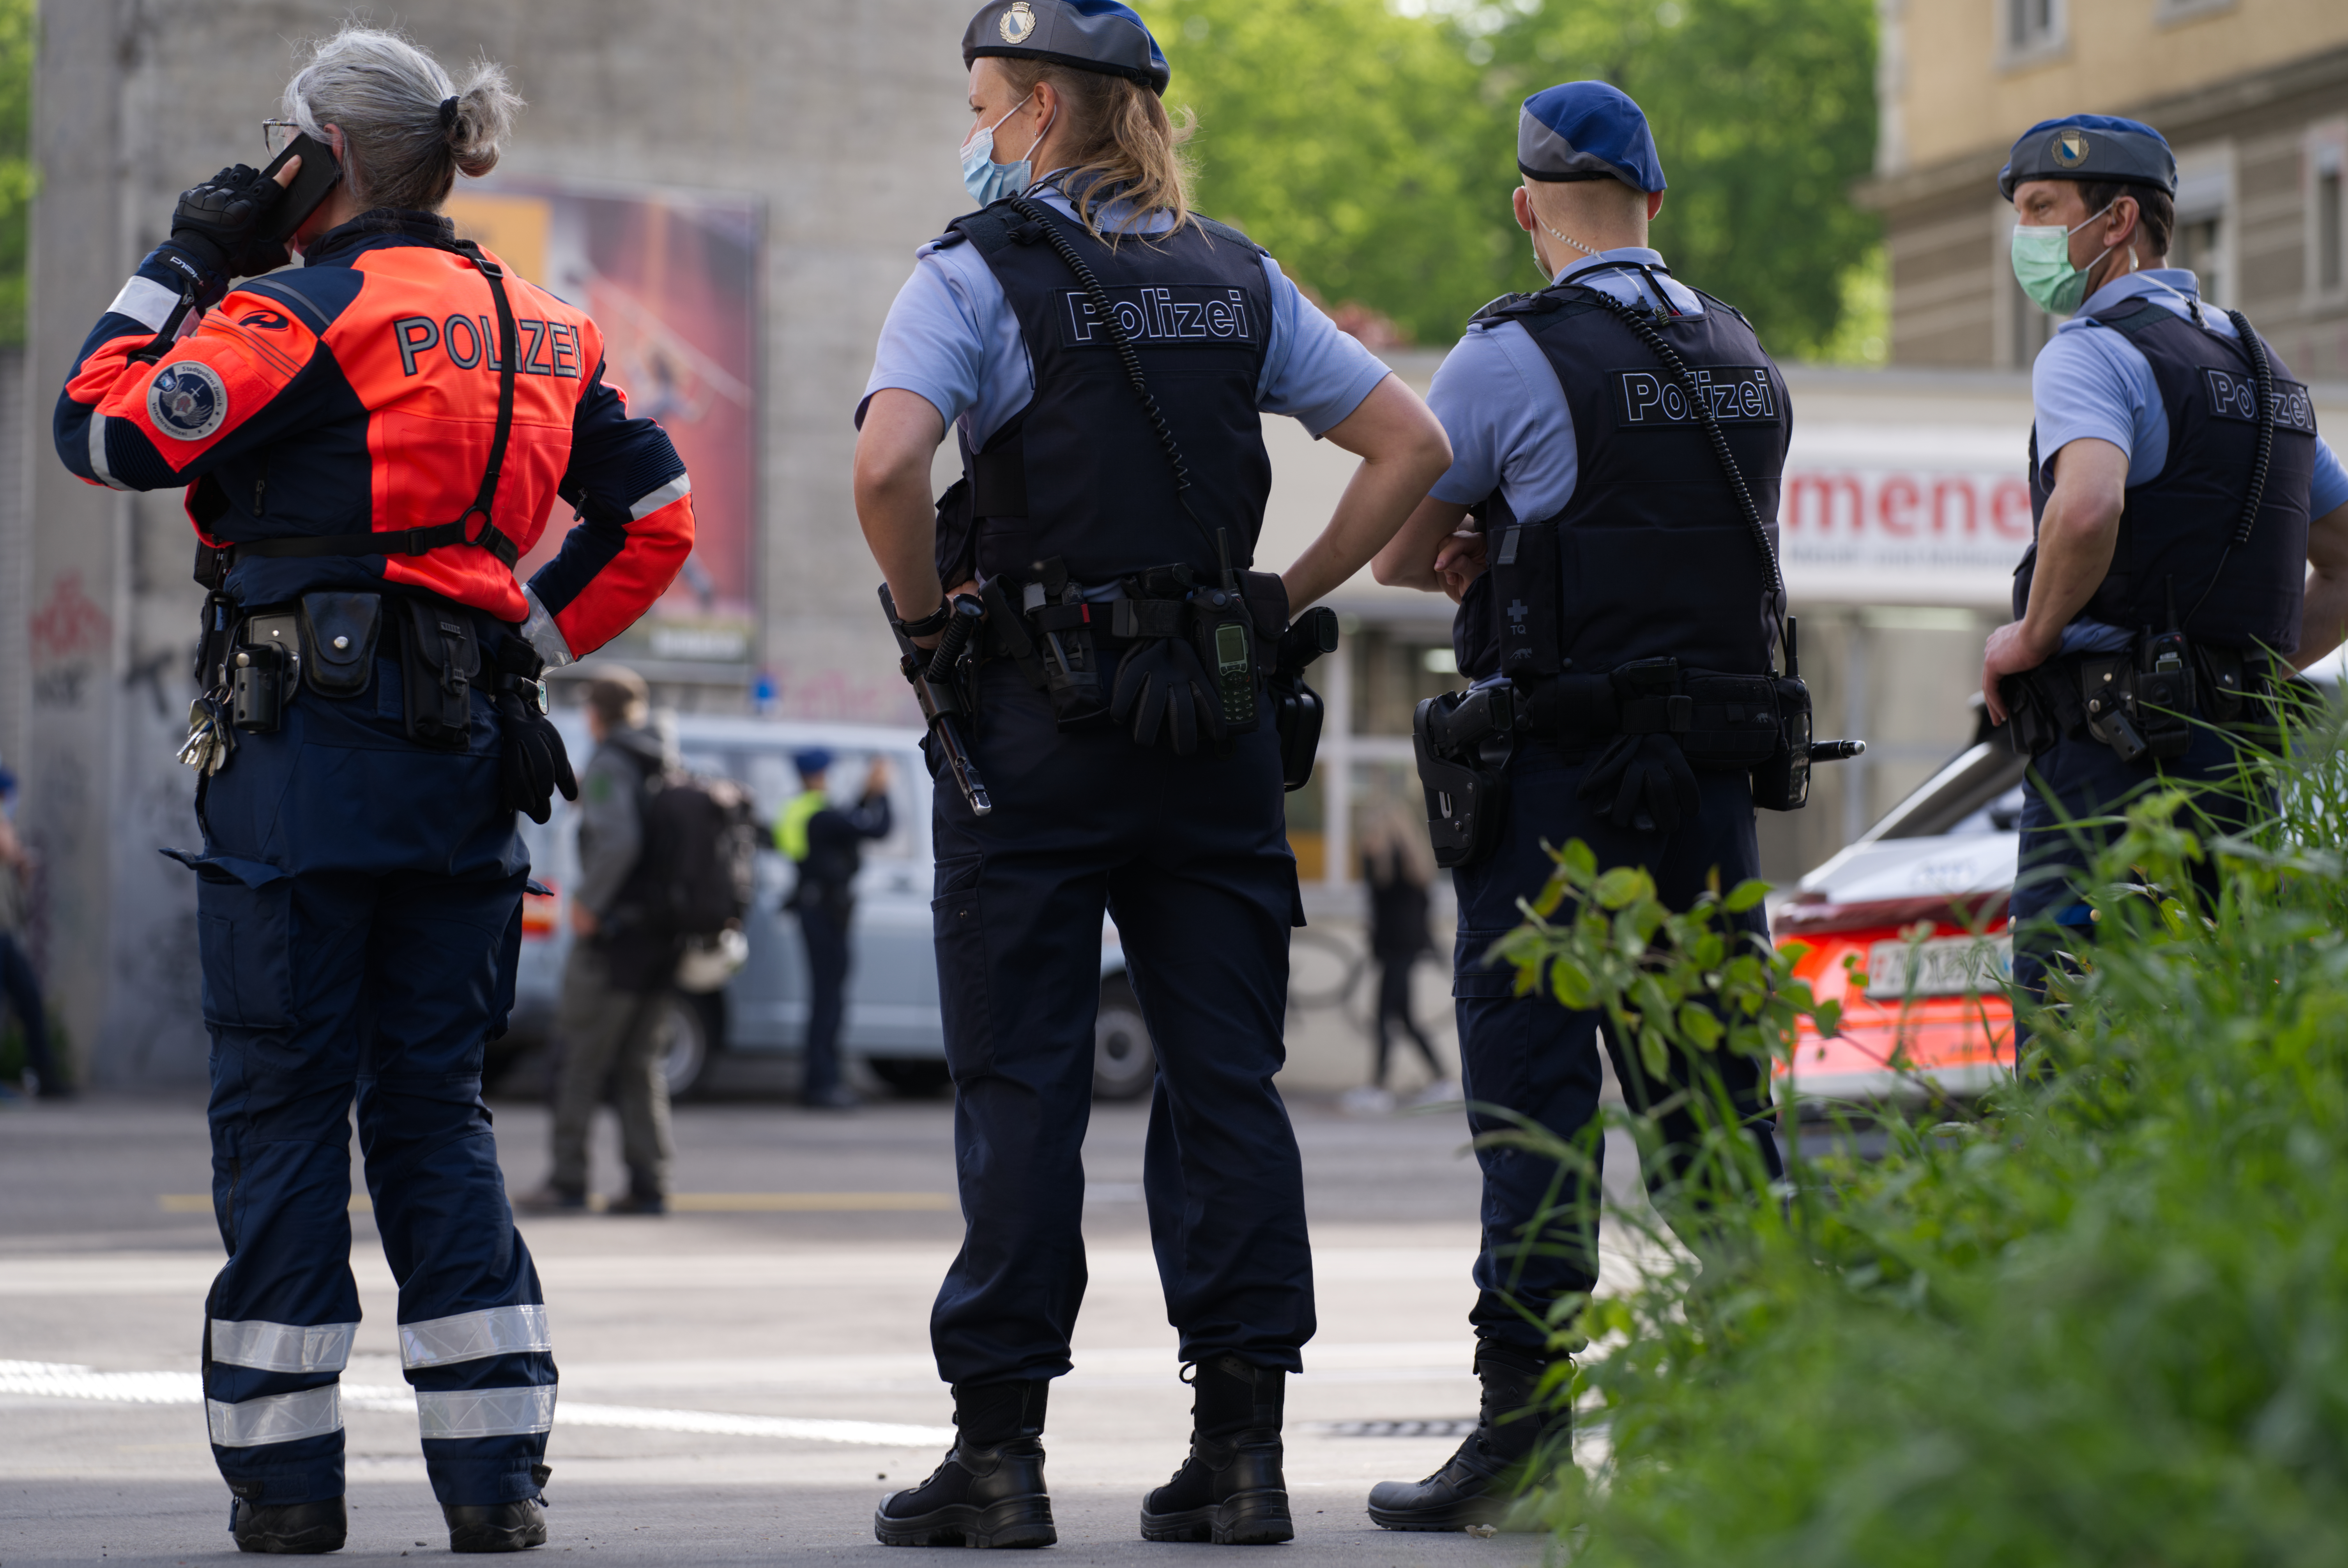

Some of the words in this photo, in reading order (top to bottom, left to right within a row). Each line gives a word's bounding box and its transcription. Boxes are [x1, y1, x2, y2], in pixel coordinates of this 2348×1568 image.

[1066, 288, 1248, 341] Polizei
[182, 366, 216, 385] Stadtpolizei
[213, 386, 223, 406] Zürich
[2208, 369, 2313, 429] Polzei
[152, 402, 187, 436] Verkehrspolizei
[1510, 624, 1527, 636] TQ
